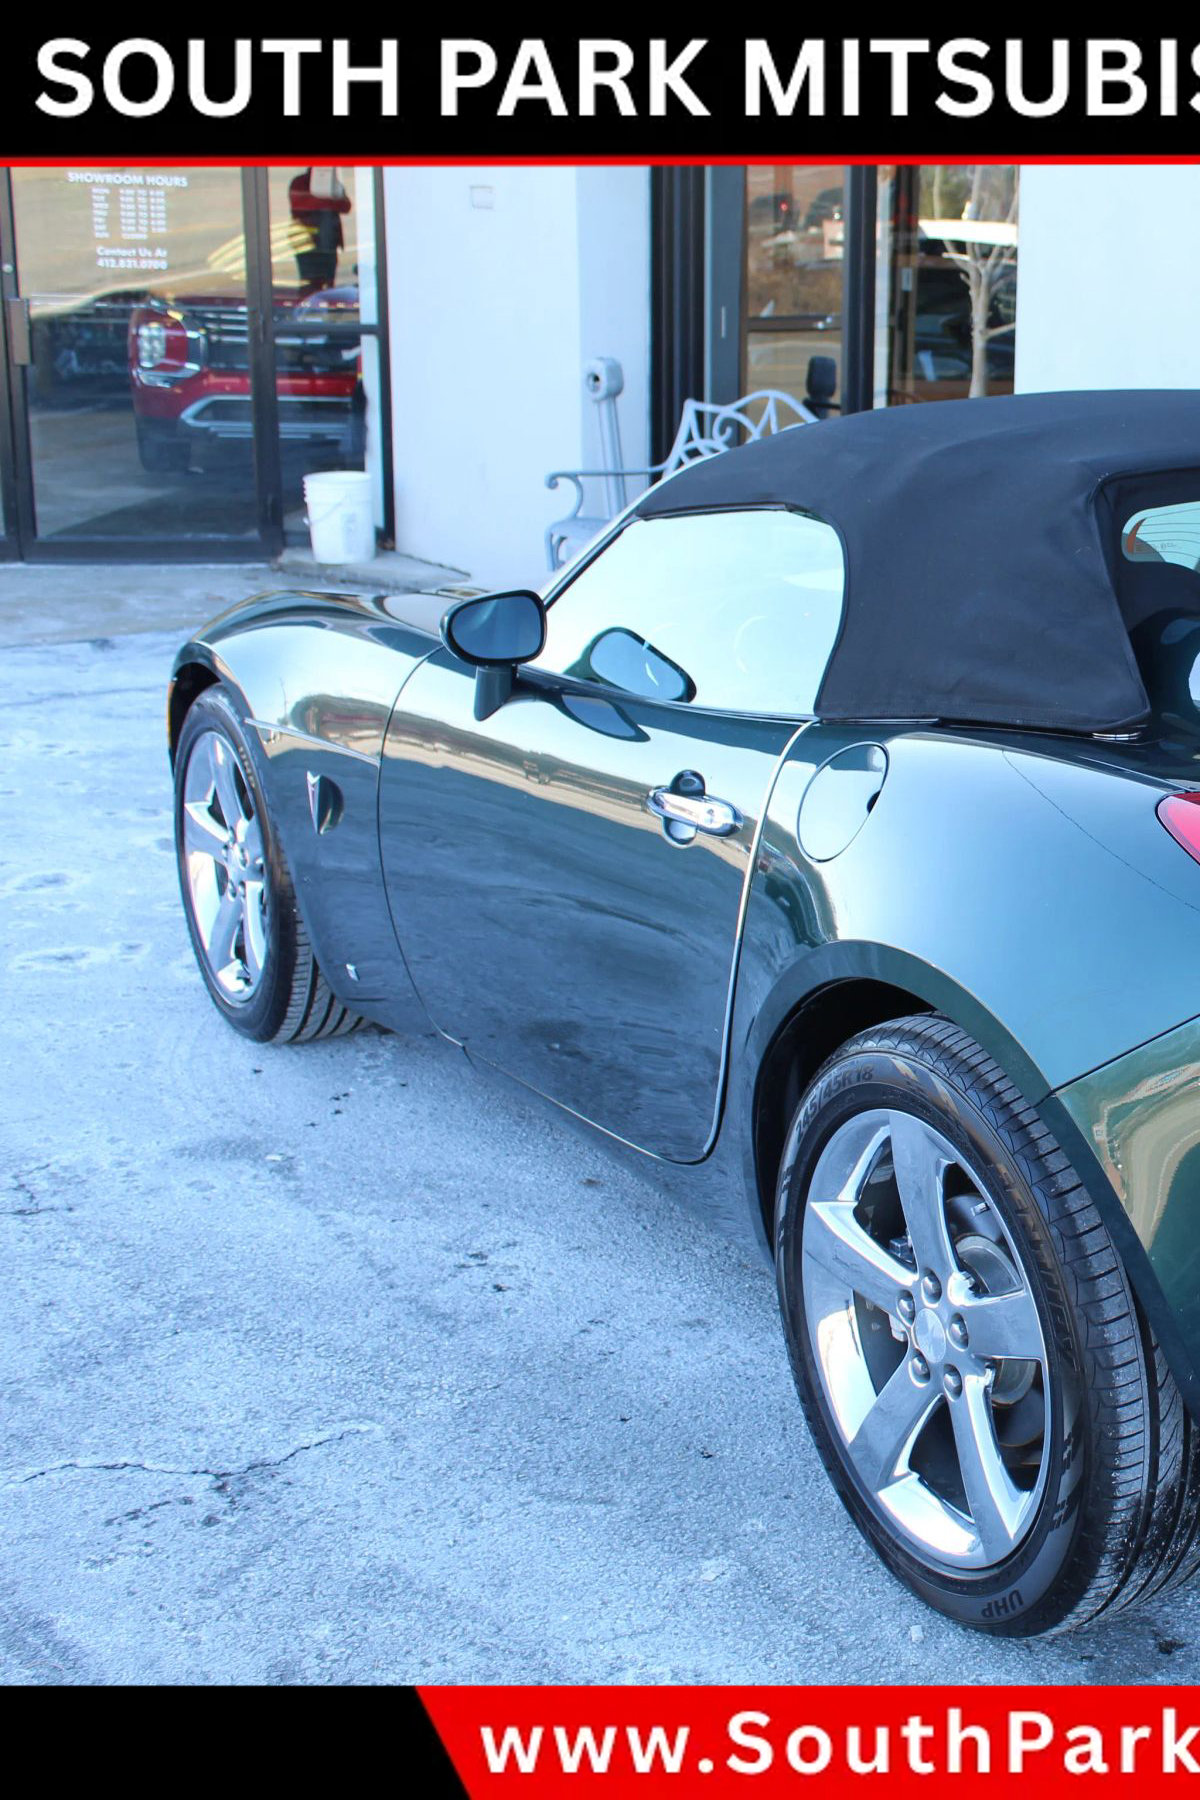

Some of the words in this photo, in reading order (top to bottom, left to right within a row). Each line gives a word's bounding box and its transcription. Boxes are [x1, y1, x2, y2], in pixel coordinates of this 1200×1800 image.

[68, 172, 144, 184] SHOWROOM
[145, 175, 188, 187] HOURS
[981, 1589, 1024, 1618] UHP
